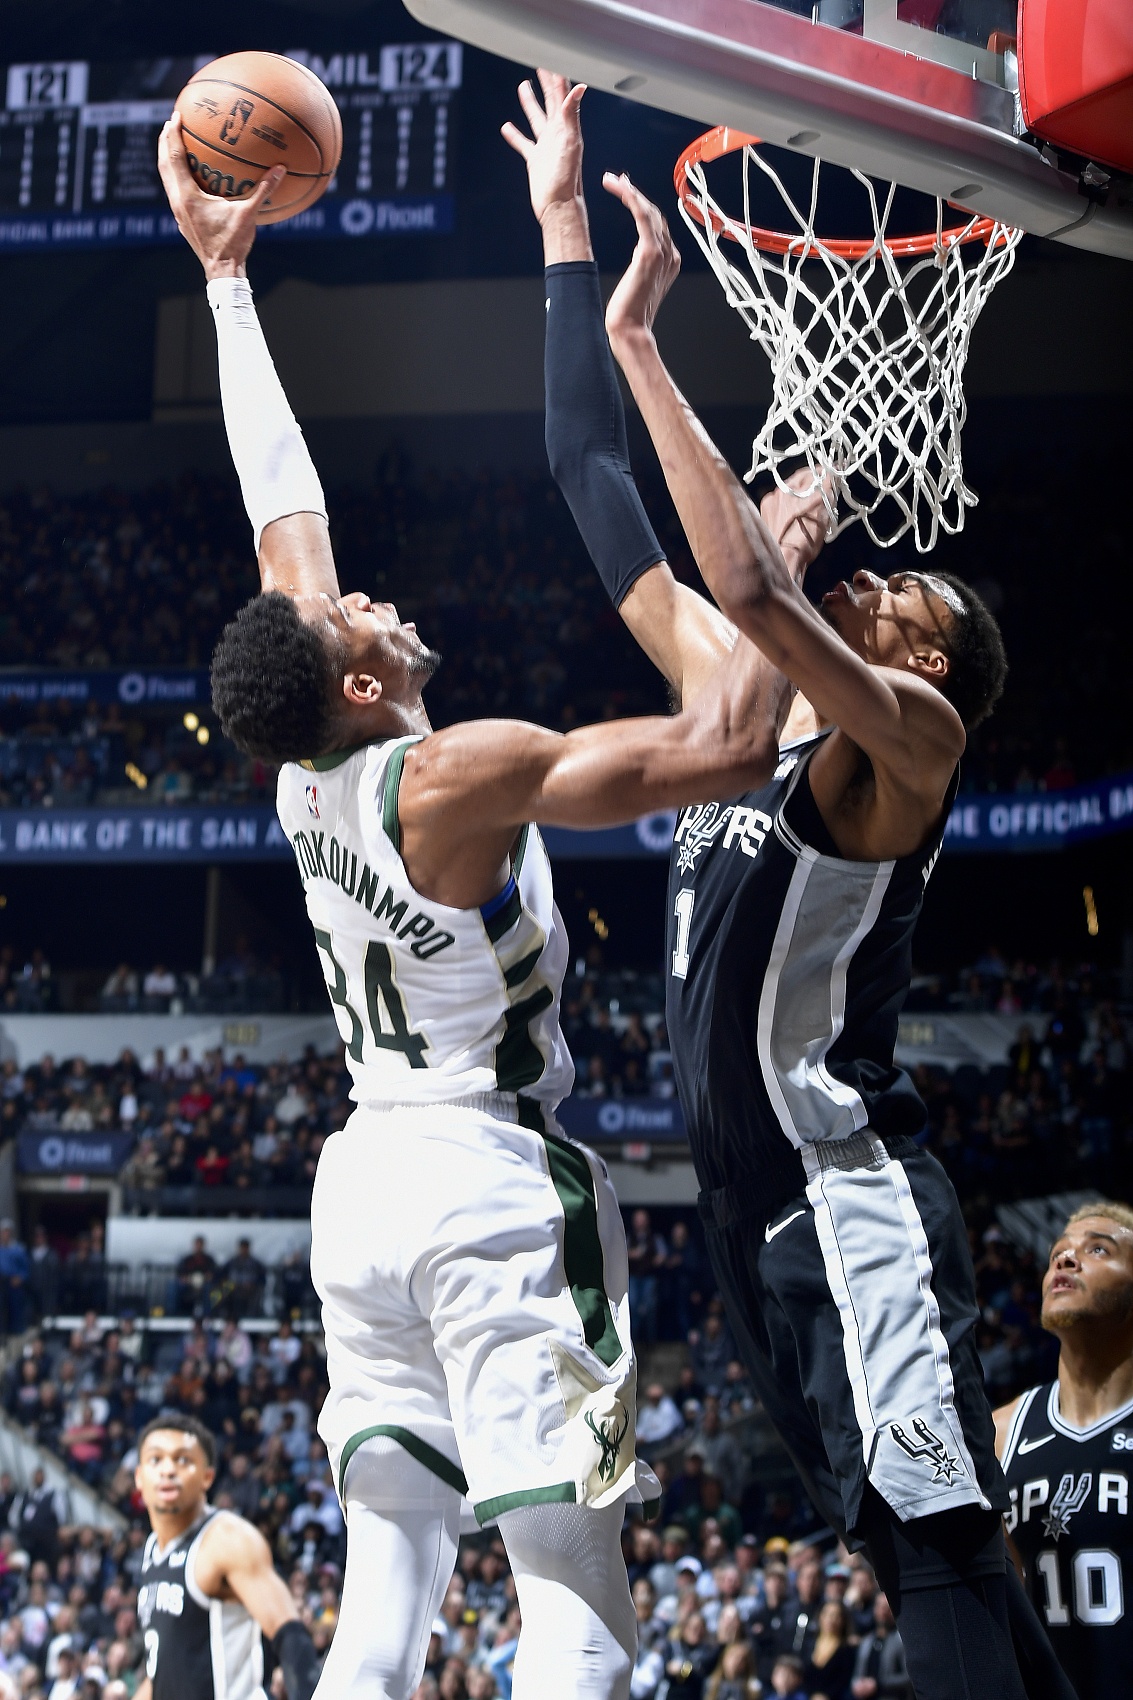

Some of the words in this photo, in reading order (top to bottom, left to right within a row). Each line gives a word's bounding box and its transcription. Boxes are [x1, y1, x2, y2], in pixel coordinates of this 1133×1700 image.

[309, 54, 378, 86] MIL
[395, 50, 449, 83] 124
[26, 69, 68, 102] 121
[16, 818, 88, 850] BANK
[97, 819, 131, 850] OF
[140, 818, 193, 849] THE
[201, 817, 257, 848] SAN
[944, 805, 979, 838] HE
[989, 796, 1104, 838] OFFICIAL
[293, 829, 456, 960] TOKOUNMPO
[672, 888, 695, 980] 1
[314, 927, 430, 1069] 34
[1112, 1433, 1133, 1451] Se
[1036, 1549, 1125, 1626] 10
